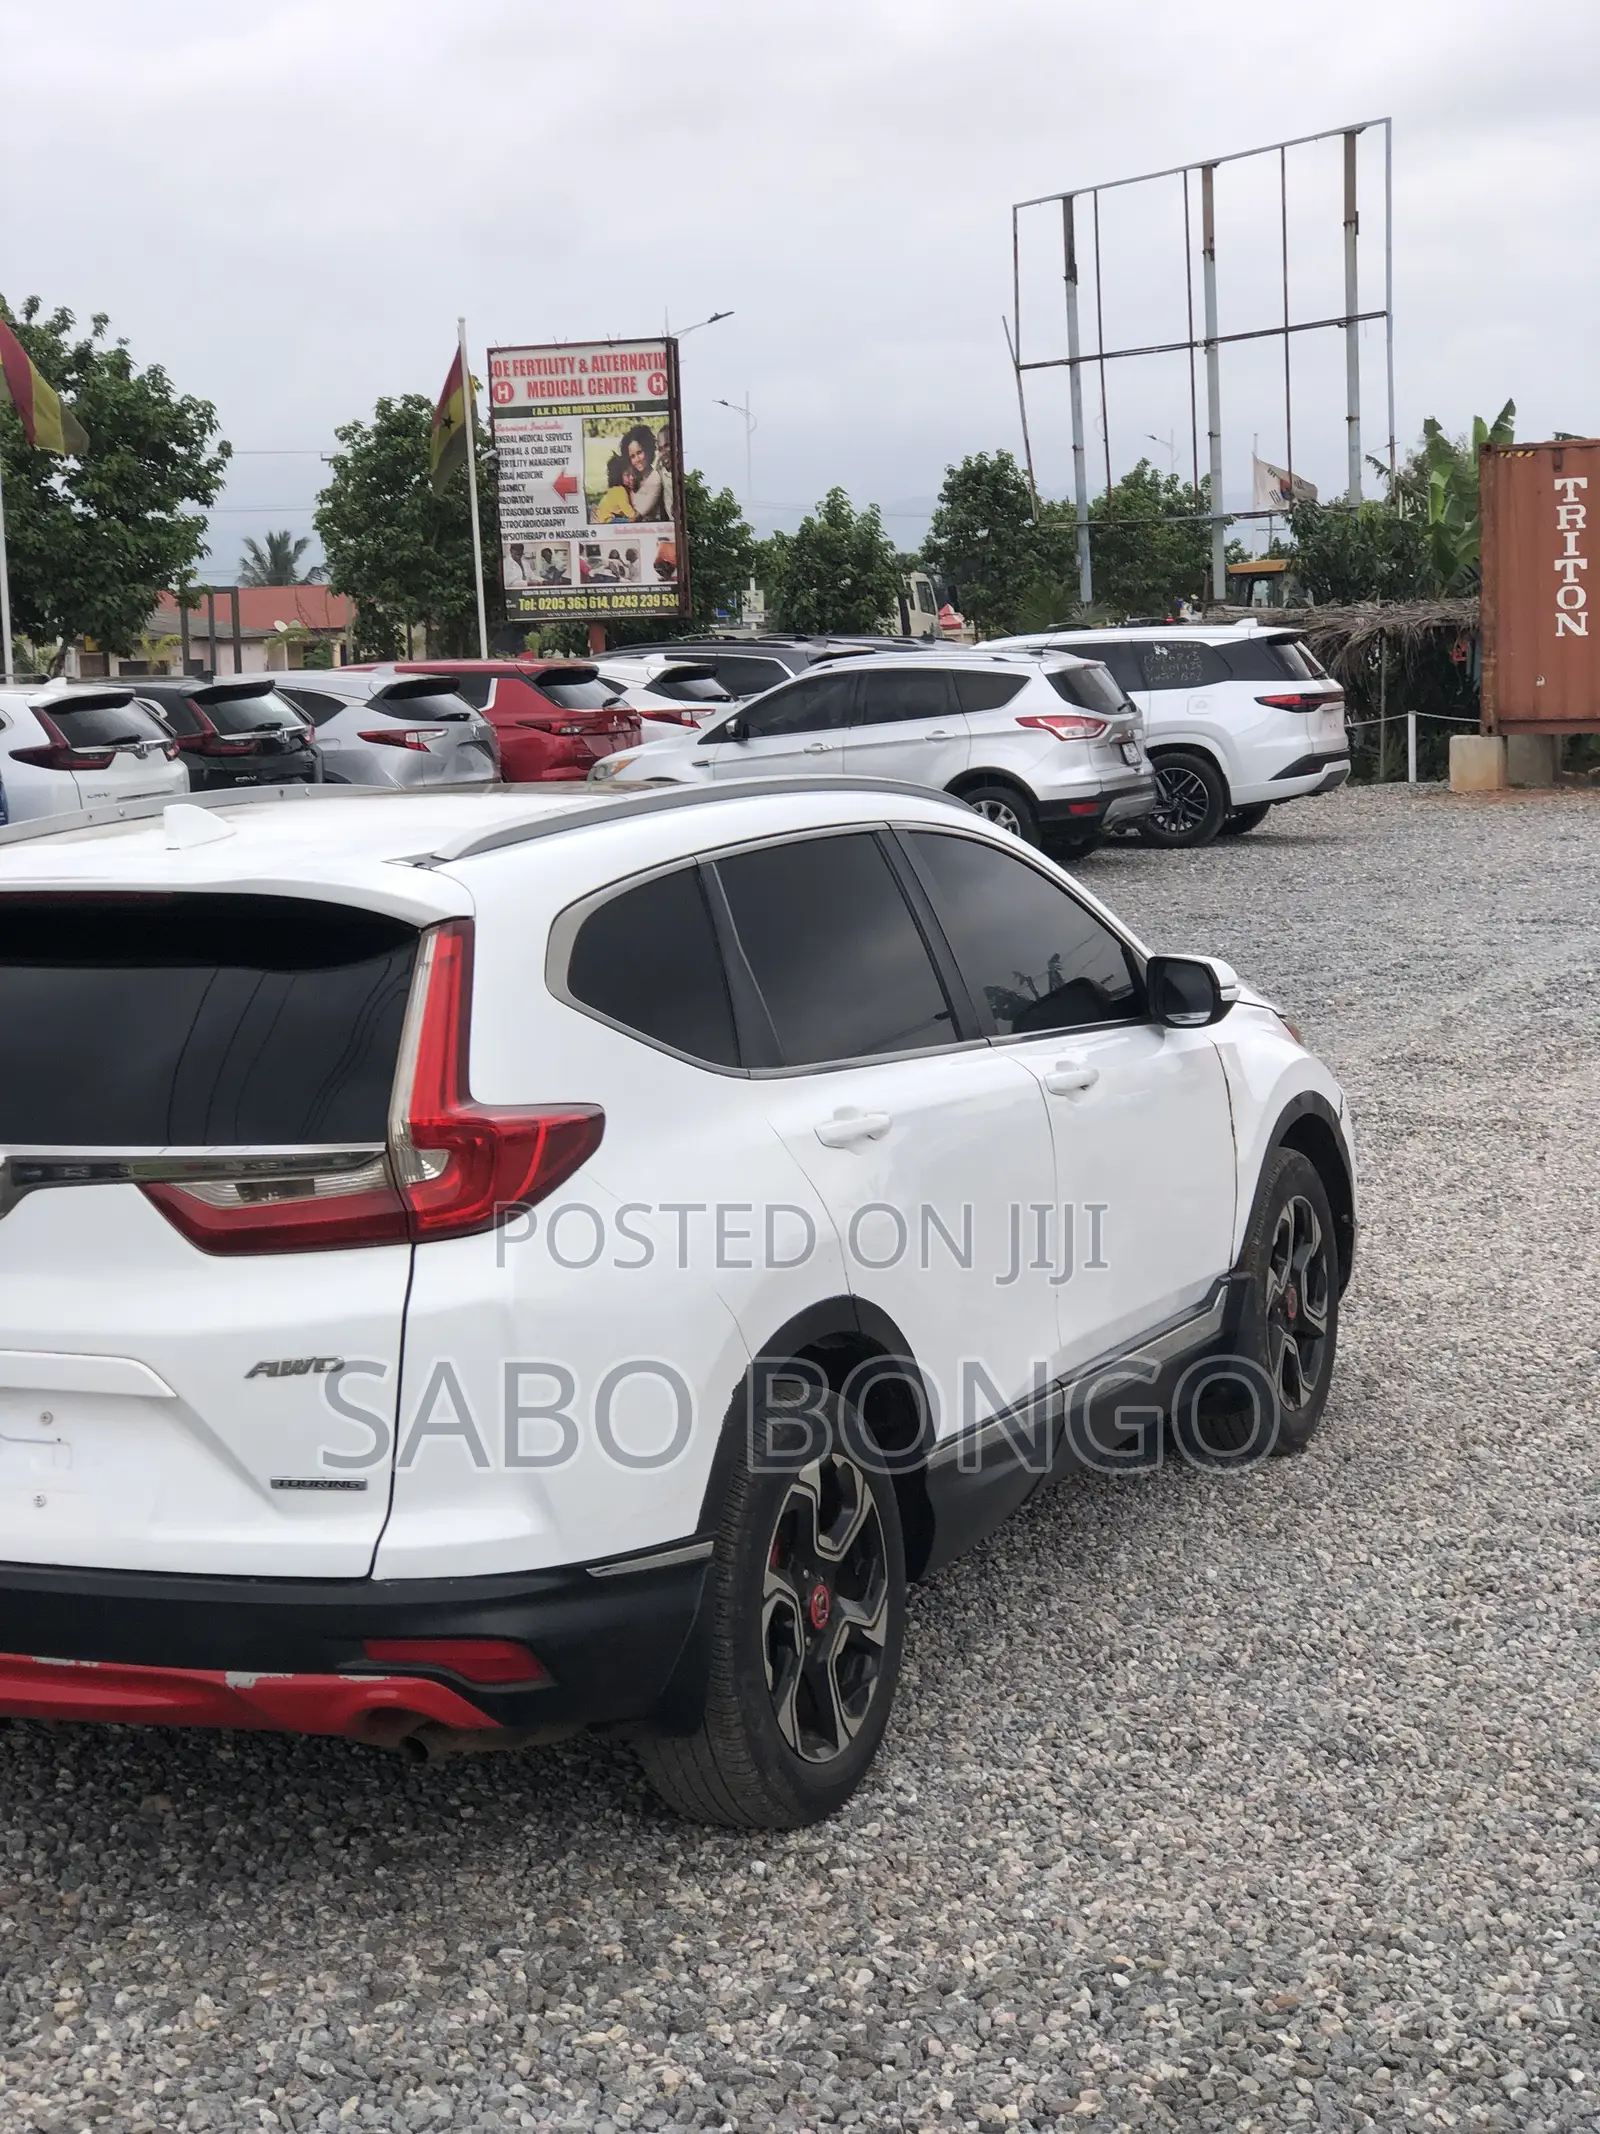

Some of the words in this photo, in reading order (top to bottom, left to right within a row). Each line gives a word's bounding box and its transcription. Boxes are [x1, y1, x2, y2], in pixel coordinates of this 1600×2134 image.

[492, 360, 510, 378] OE
[513, 356, 575, 377] FERTILITY
[579, 358, 588, 373] &
[527, 378, 584, 398] MEDICAL
[588, 376, 637, 395] CENTRE
[596, 403, 630, 413] HOSPITAL
[495, 435, 517, 444] ENERAL
[519, 434, 544, 443] MEDICAL
[545, 432, 573, 441] SERVICES
[524, 447, 530, 455] &
[531, 446, 548, 455] CHILD
[549, 445, 572, 453] HEALTH
[529, 457, 569, 466] MANAGEMENT
[499, 472, 515, 480] ERBAL
[516, 471, 543, 480] MEDICINE
[500, 508, 534, 517] LTRASOUND
[535, 507, 551, 516] SCAN
[552, 506, 579, 514] SERVICES
[502, 532, 547, 541] HYSIOTHERAPY
[556, 530, 589, 539] MASSAGING
[1554, 477, 1589, 637] TRITON
[518, 598, 537, 611] Tel:
[538, 597, 566, 610] 0205
[567, 596, 588, 610] 363
[589, 595, 610, 609] 614,
[611, 595, 639, 608] 0243
[640, 594, 660, 607] 239
[244, 1356, 345, 1378] AWD
[275, 1479, 361, 1490] TOURING
